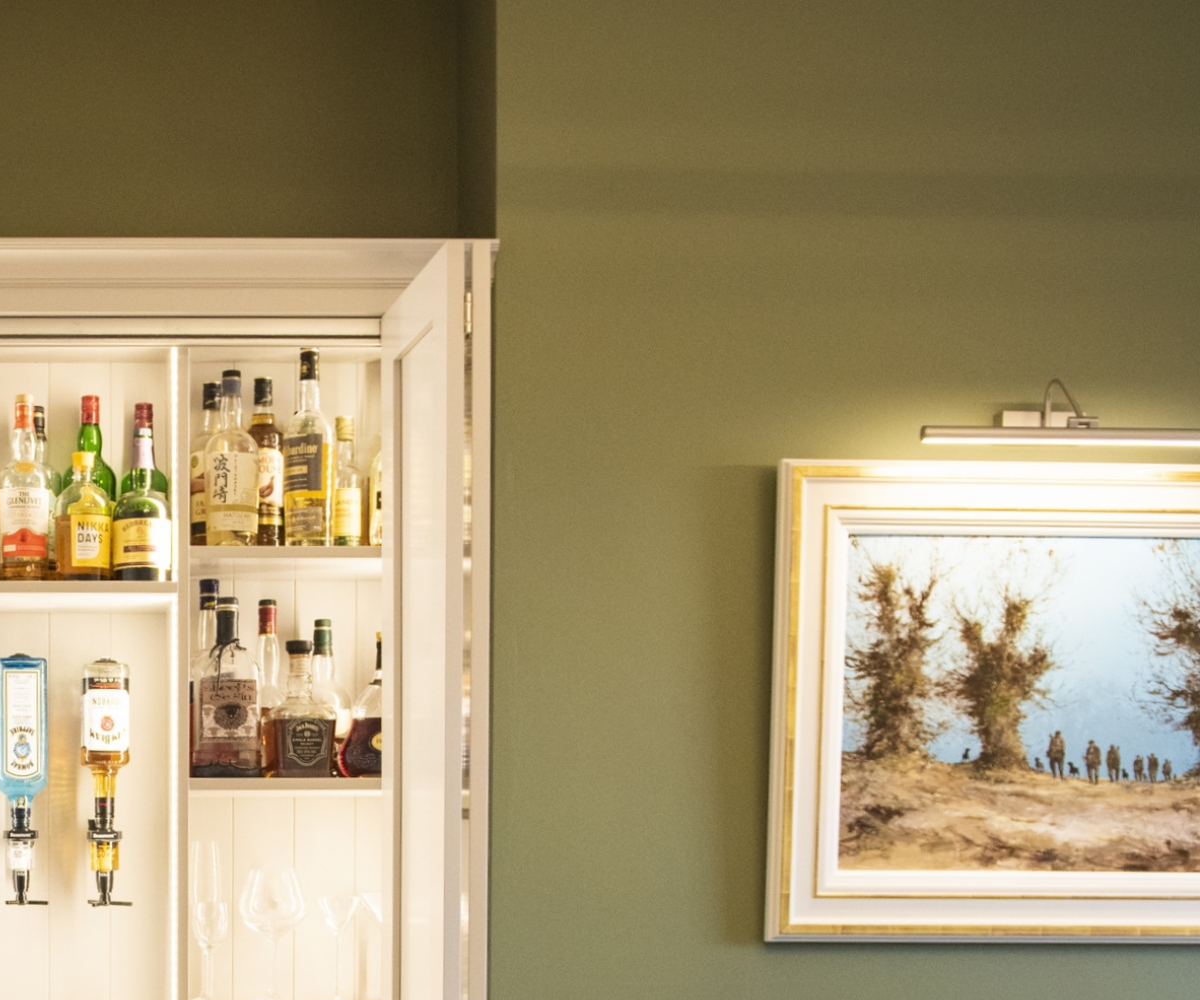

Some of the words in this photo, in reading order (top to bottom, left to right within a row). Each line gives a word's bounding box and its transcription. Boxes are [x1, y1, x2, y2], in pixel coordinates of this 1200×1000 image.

[6, 497, 42, 506] GLENLIVET
[77, 521, 109, 532] NIKKA
[77, 533, 104, 544] DAYS
[10, 760, 34, 770] BOMBAY
